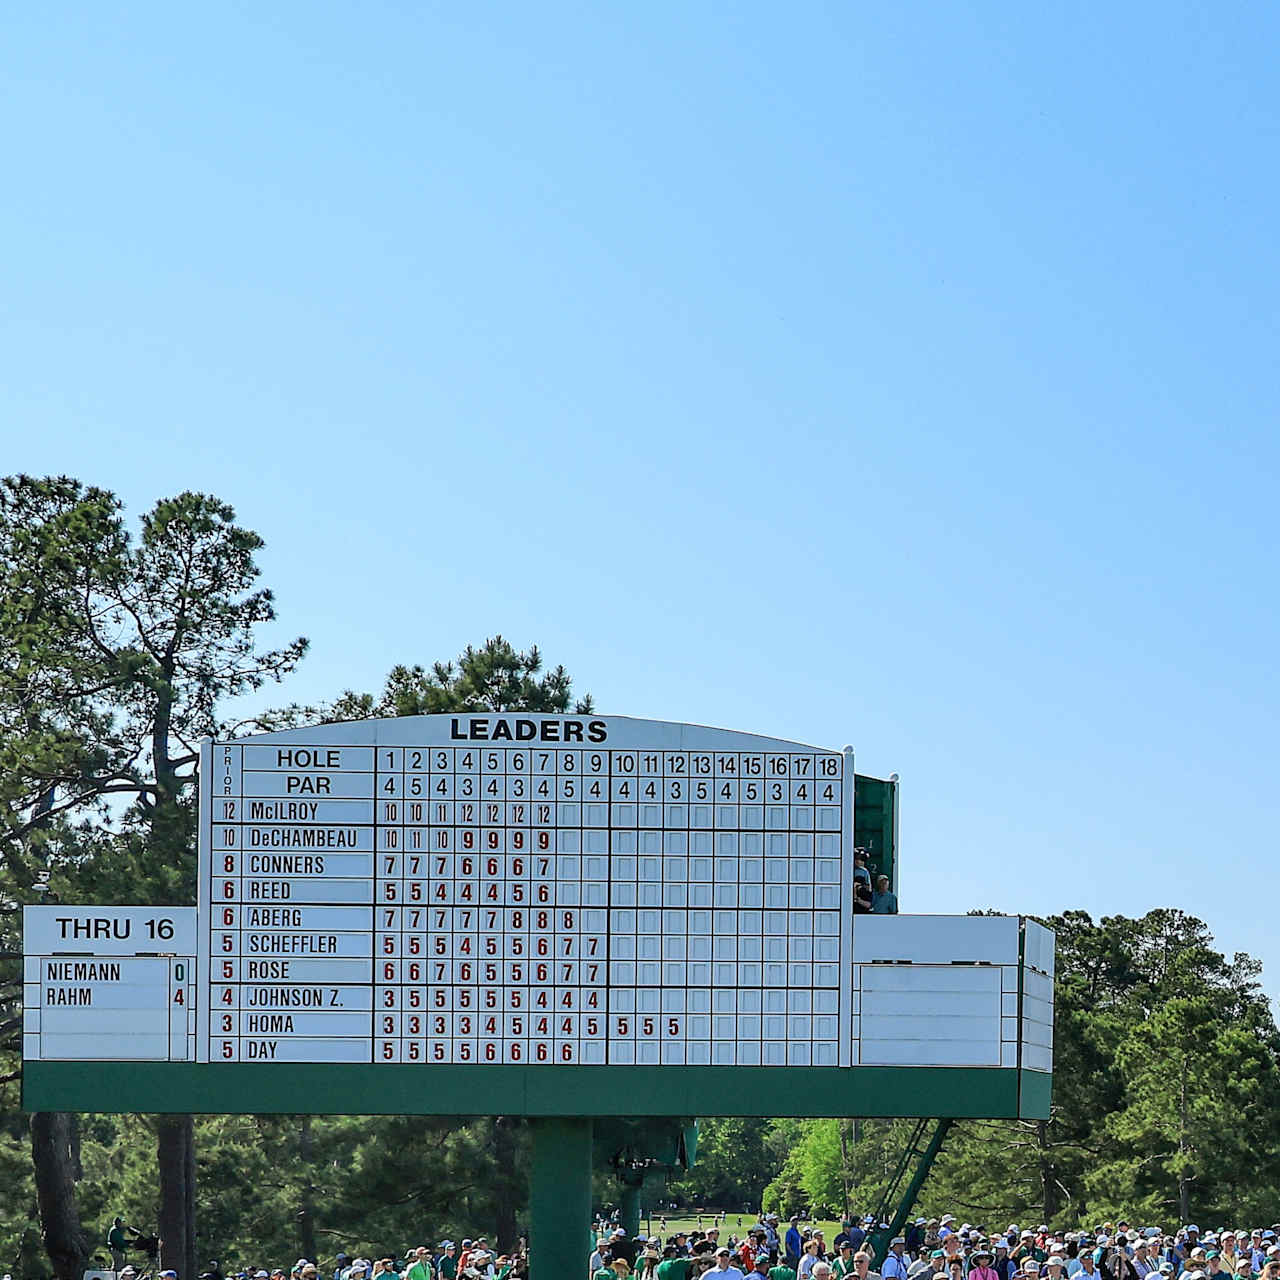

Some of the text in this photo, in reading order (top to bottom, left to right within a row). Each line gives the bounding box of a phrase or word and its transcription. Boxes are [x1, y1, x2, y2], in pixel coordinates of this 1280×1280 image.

[451, 718, 608, 743] LEADERS
[223, 746, 232, 795] PRIOR
[277, 749, 838, 776] HOLE 1 2 3 4 5 6 7 8 9 10 11 12 13 14 15 16 17 18
[287, 776, 834, 802] PAR 4 5 4 3 4 3 4 5 4 4 4 3 5 4 5 3 4 4
[223, 801, 550, 824] 12 McILROY 10 10 11 12 12 12 12
[223, 828, 550, 850] 10 DeCHAMBEAU 10 11 10 9 9 9 9
[223, 855, 549, 876] 8 CONNERS 7 7 7 6 6 6 7
[224, 881, 549, 903] 6 REED 5 5 4 4 4 5 6
[55, 918, 174, 940] THRU 16
[223, 907, 574, 930] 6 ABERG 7 7 7 7 7 8 8 8
[222, 934, 598, 956] 5 SCHEFFLER 5 5 5 4 5 5 6 7 7
[47, 962, 120, 981] NIEMANN
[223, 960, 599, 982] 5 ROSE 6 6 7 6 5 5 6 7 7
[47, 987, 185, 1006] RAHM 4
[221, 988, 598, 1009] 4 JOHNSON Z. 3 5 5 5 5 5 4 4 4
[222, 1014, 679, 1036] 3 HOMA 3 3 3 3 4 5 4 4 5 5 5 5
[222, 1041, 572, 1062] 5 DAY 5 5 5 5 6 6 6 6
